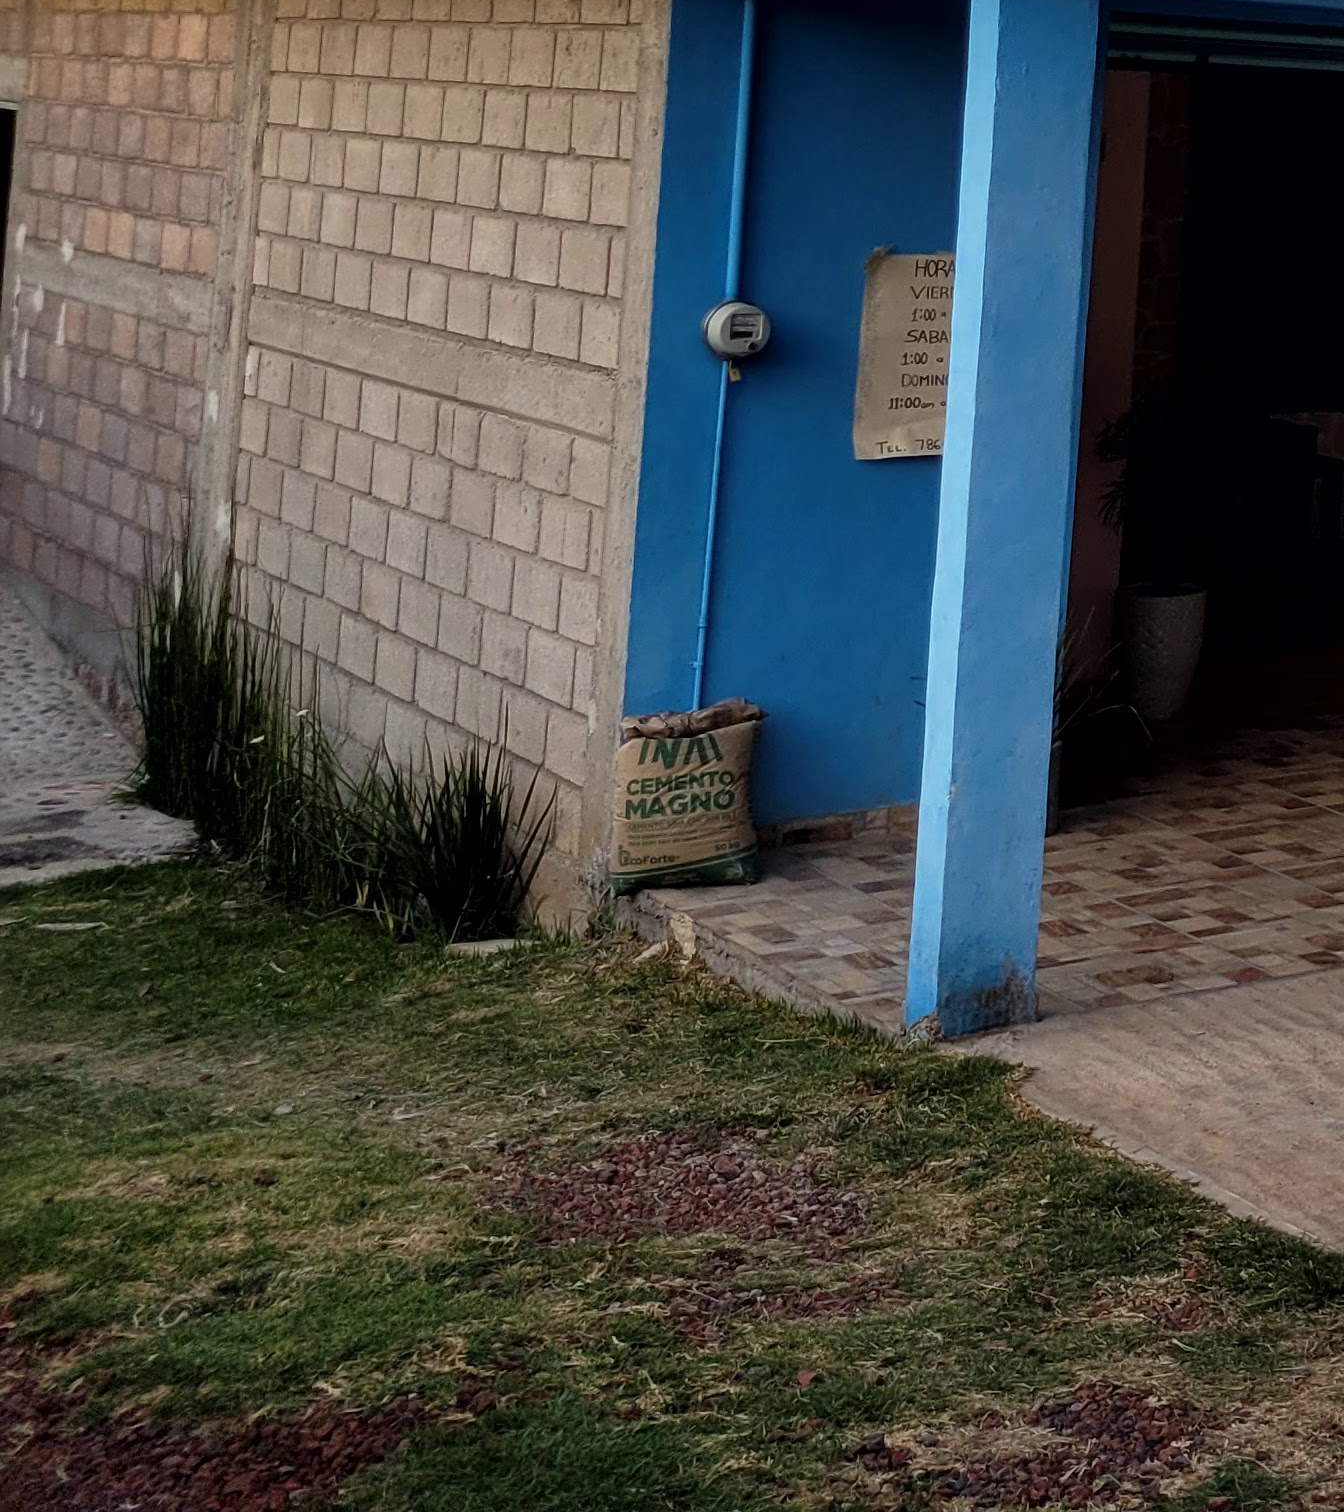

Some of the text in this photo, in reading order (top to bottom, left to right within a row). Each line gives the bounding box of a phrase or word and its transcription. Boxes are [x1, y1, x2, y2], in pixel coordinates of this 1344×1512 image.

[901, 352, 928, 366] 1:00
[626, 770, 736, 796] CEMENTO
[625, 789, 736, 820] MAGNO
